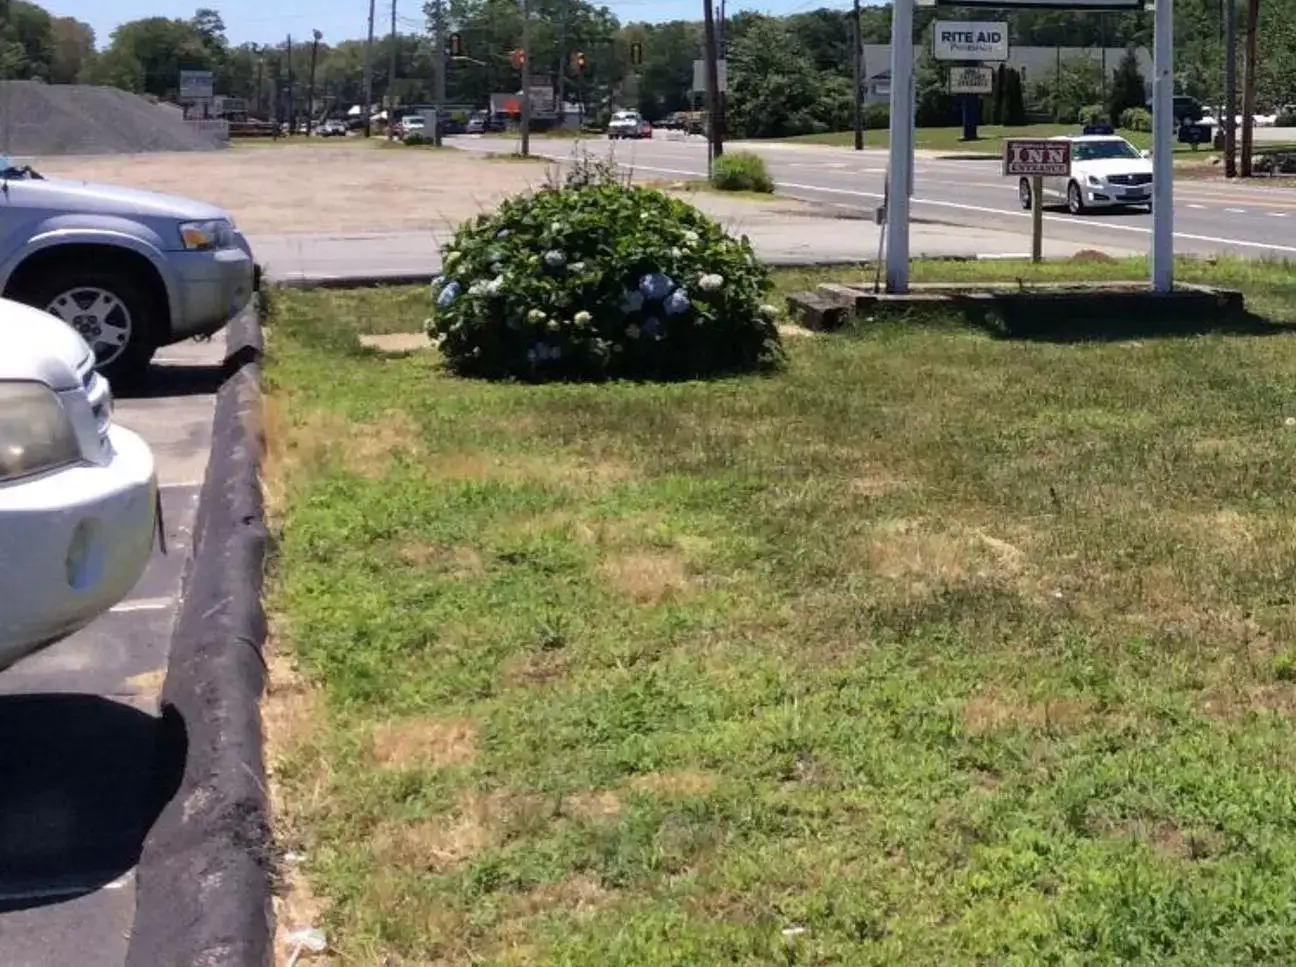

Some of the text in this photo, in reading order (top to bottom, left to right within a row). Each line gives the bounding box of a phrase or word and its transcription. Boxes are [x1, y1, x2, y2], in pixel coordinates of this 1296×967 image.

[941, 31, 1002, 44] RITE AID
[1011, 148, 1066, 163] INN
